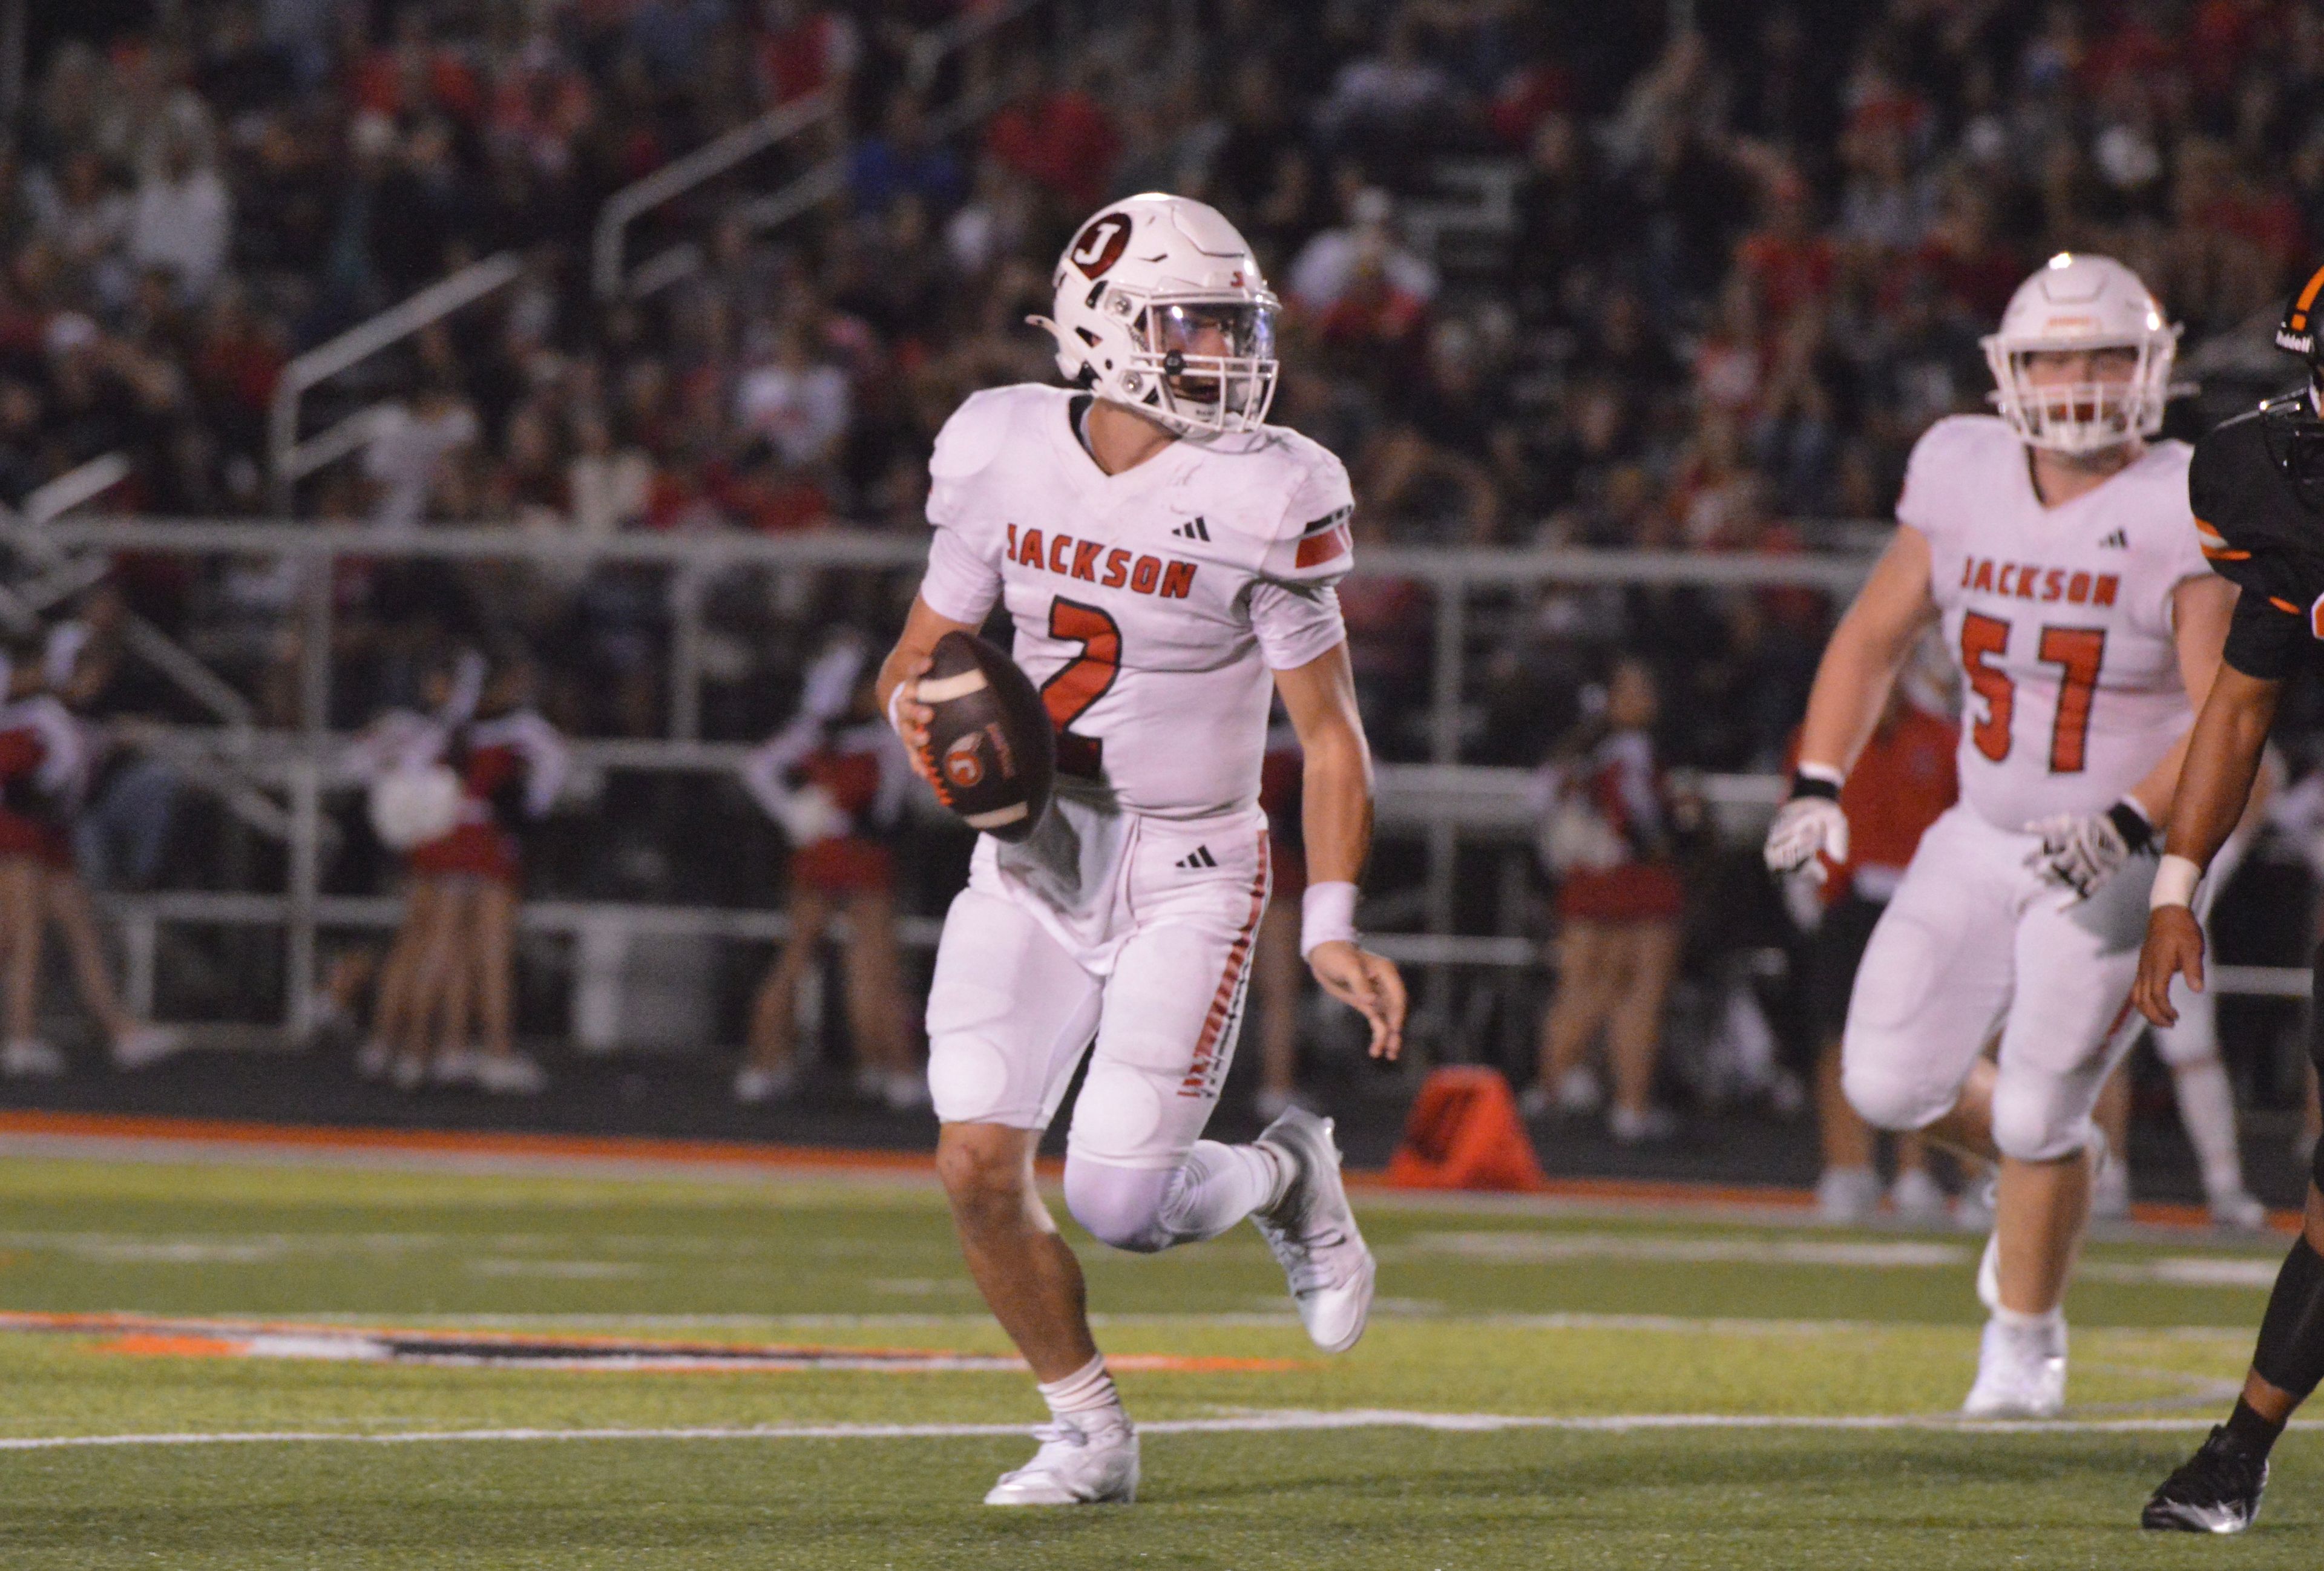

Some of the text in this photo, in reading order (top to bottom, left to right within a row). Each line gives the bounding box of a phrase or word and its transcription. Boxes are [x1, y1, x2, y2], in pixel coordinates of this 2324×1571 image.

[1074, 223, 1121, 265] J
[1007, 523, 1198, 599] JACKSON
[1961, 555, 2121, 607] JACKSON
[1039, 594, 1123, 781] 2
[1961, 609, 2107, 774] 57
